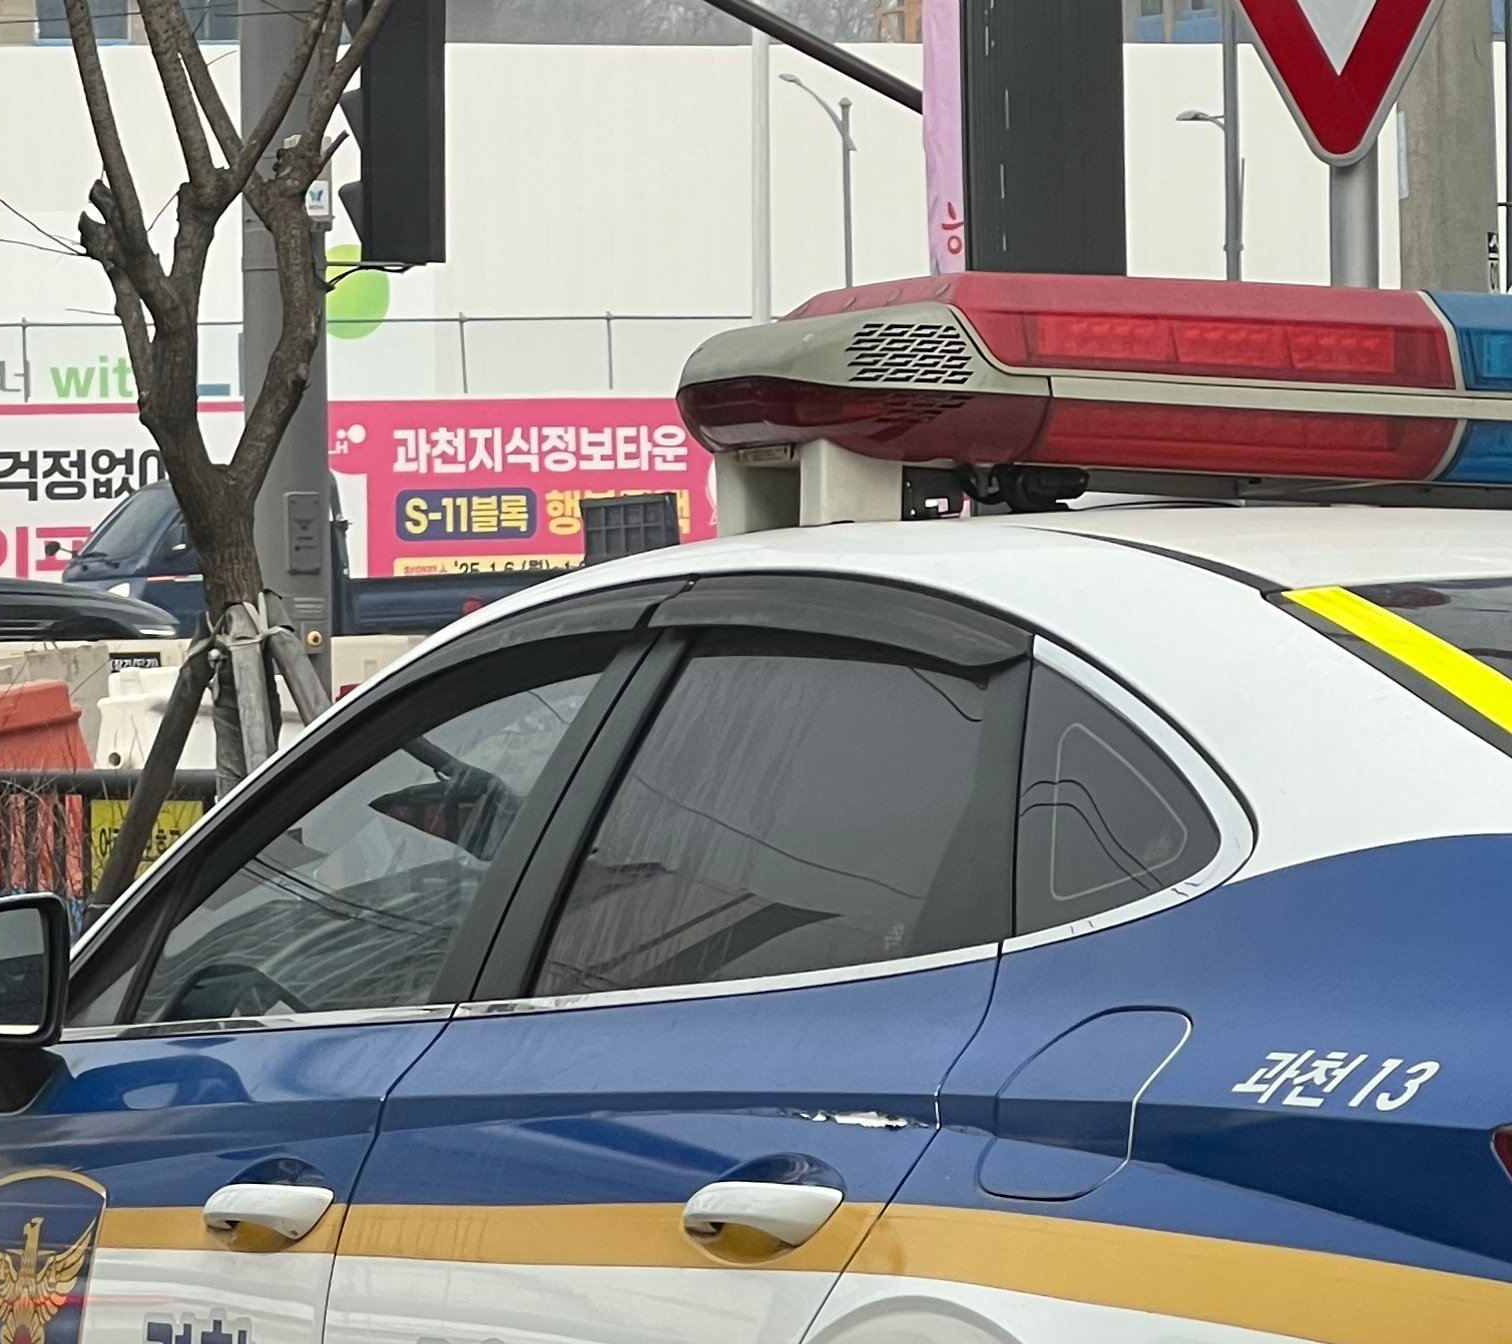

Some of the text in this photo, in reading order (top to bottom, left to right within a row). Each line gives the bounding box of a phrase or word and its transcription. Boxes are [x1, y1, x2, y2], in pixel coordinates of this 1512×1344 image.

[50, 355, 134, 398] wit
[393, 425, 689, 475] 과천지식정보타운
[405, 494, 529, 535] S-11블록
[1232, 1050, 1440, 1112] 과천 13
